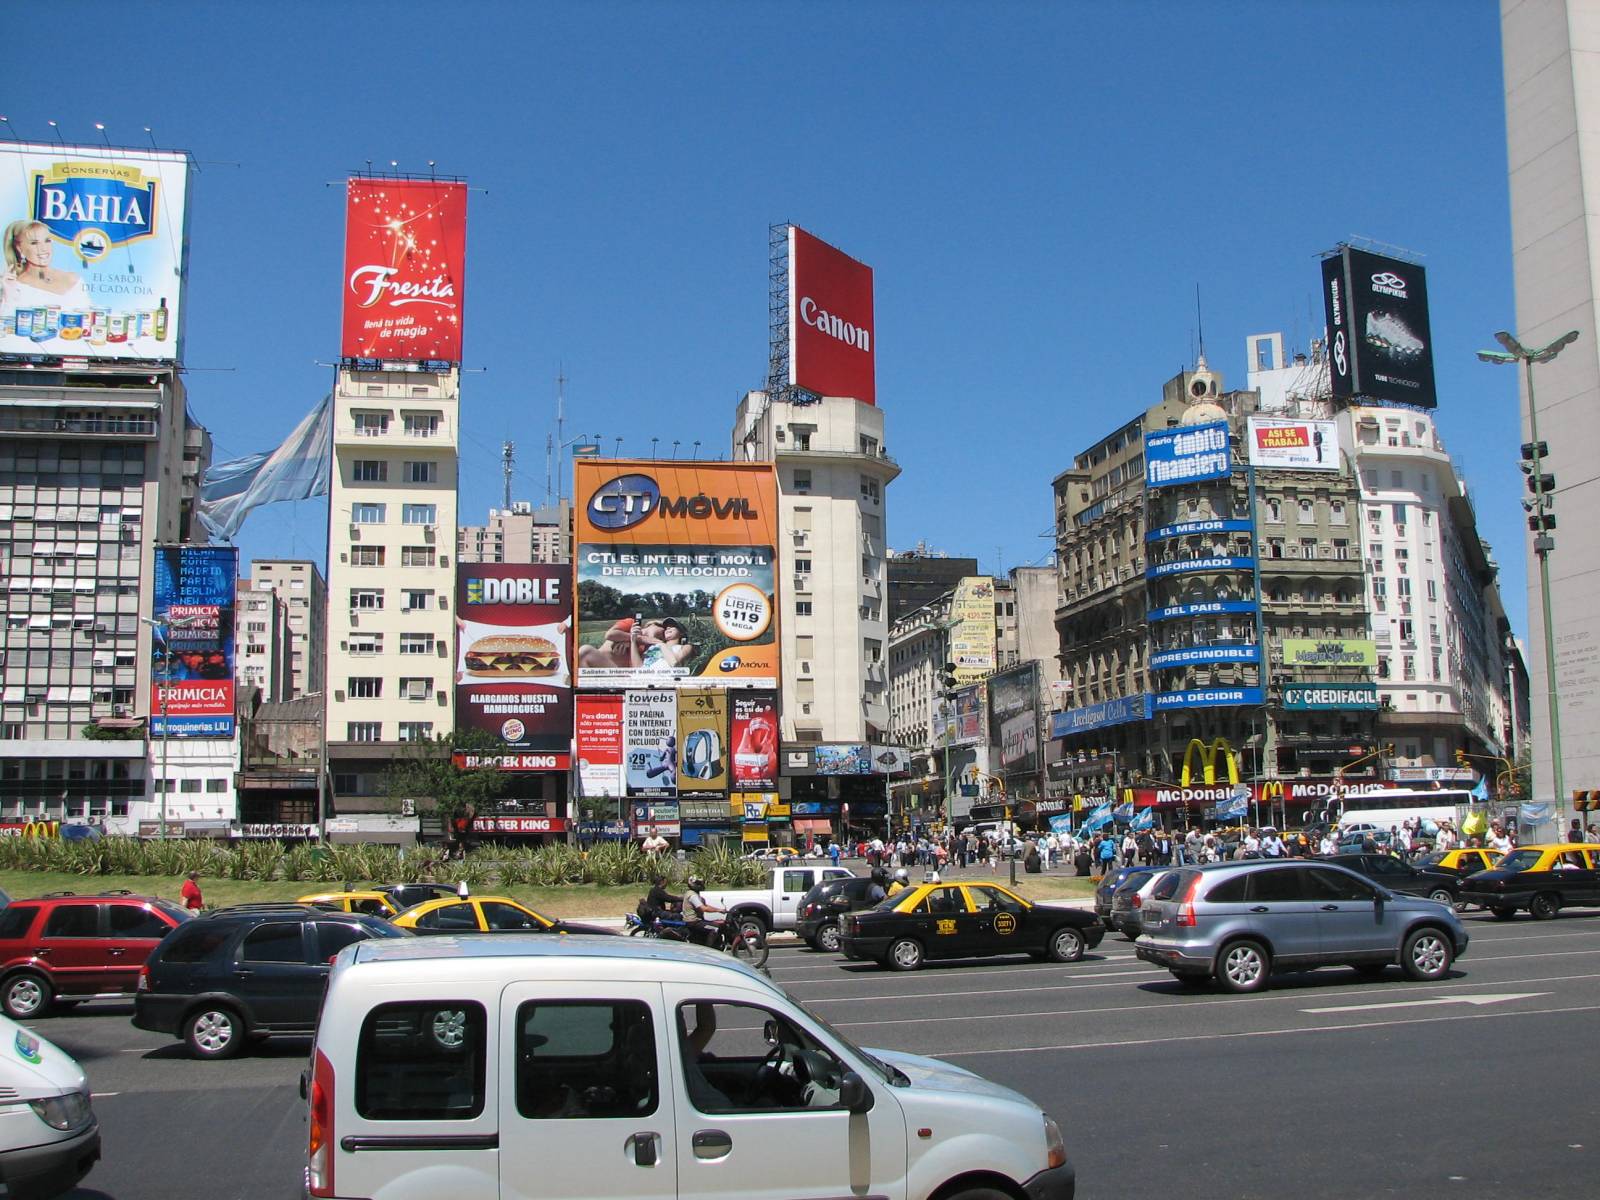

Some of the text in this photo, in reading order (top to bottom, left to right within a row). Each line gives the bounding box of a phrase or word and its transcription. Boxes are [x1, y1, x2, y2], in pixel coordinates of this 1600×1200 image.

[61, 166, 130, 177] CONSERVAS
[93, 273, 143, 284] EL SABOR
[81, 283, 95, 293] DE
[99, 284, 130, 295] CADA
[350, 265, 455, 306] Fresita
[385, 318, 394, 326] tu
[396, 316, 415, 325] vida
[801, 296, 870, 352] Canon
[380, 325, 427, 339] de magia
[1285, 429, 1296, 437] SE
[1148, 428, 1226, 456] diario ámbito
[1262, 438, 1304, 446] TRABAJA
[1149, 452, 1228, 482] financiero
[659, 493, 758, 520] MÓVIL
[1160, 522, 1223, 536] EL MEJOR
[620, 554, 639, 564] ES
[644, 555, 716, 566] INTERNET
[1156, 558, 1232, 572] INFORMADO
[180, 567, 222, 576] MADRID
[602, 567, 752, 578] DE ALTA VELOCIDAD.
[180, 577, 214, 585] PARIS
[180, 587, 216, 596] BERLIN
[484, 578, 560, 604] DOBLE
[171, 606, 219, 616] PRIMICIA
[726, 598, 763, 613] LIBRE
[1164, 606, 1186, 616] DEL
[723, 610, 759, 623] $119
[732, 622, 754, 630] MEGA
[1151, 650, 1254, 664] IMPRESCINDIBLE
[158, 688, 226, 700] PRIMICIA
[470, 694, 558, 704] ALARGAMOS NUESTRA
[629, 693, 674, 702] towebs
[1156, 692, 1244, 704] PARA DECIDIR
[1304, 690, 1376, 704] CREDIFACIL
[484, 704, 546, 714] HAMBURGUESA
[214, 722, 230, 732] LILI
[645, 728, 670, 736] DISEÑO
[522, 756, 557, 768] KING
[1292, 784, 1384, 797] McDonald's
[521, 820, 550, 830] KING
